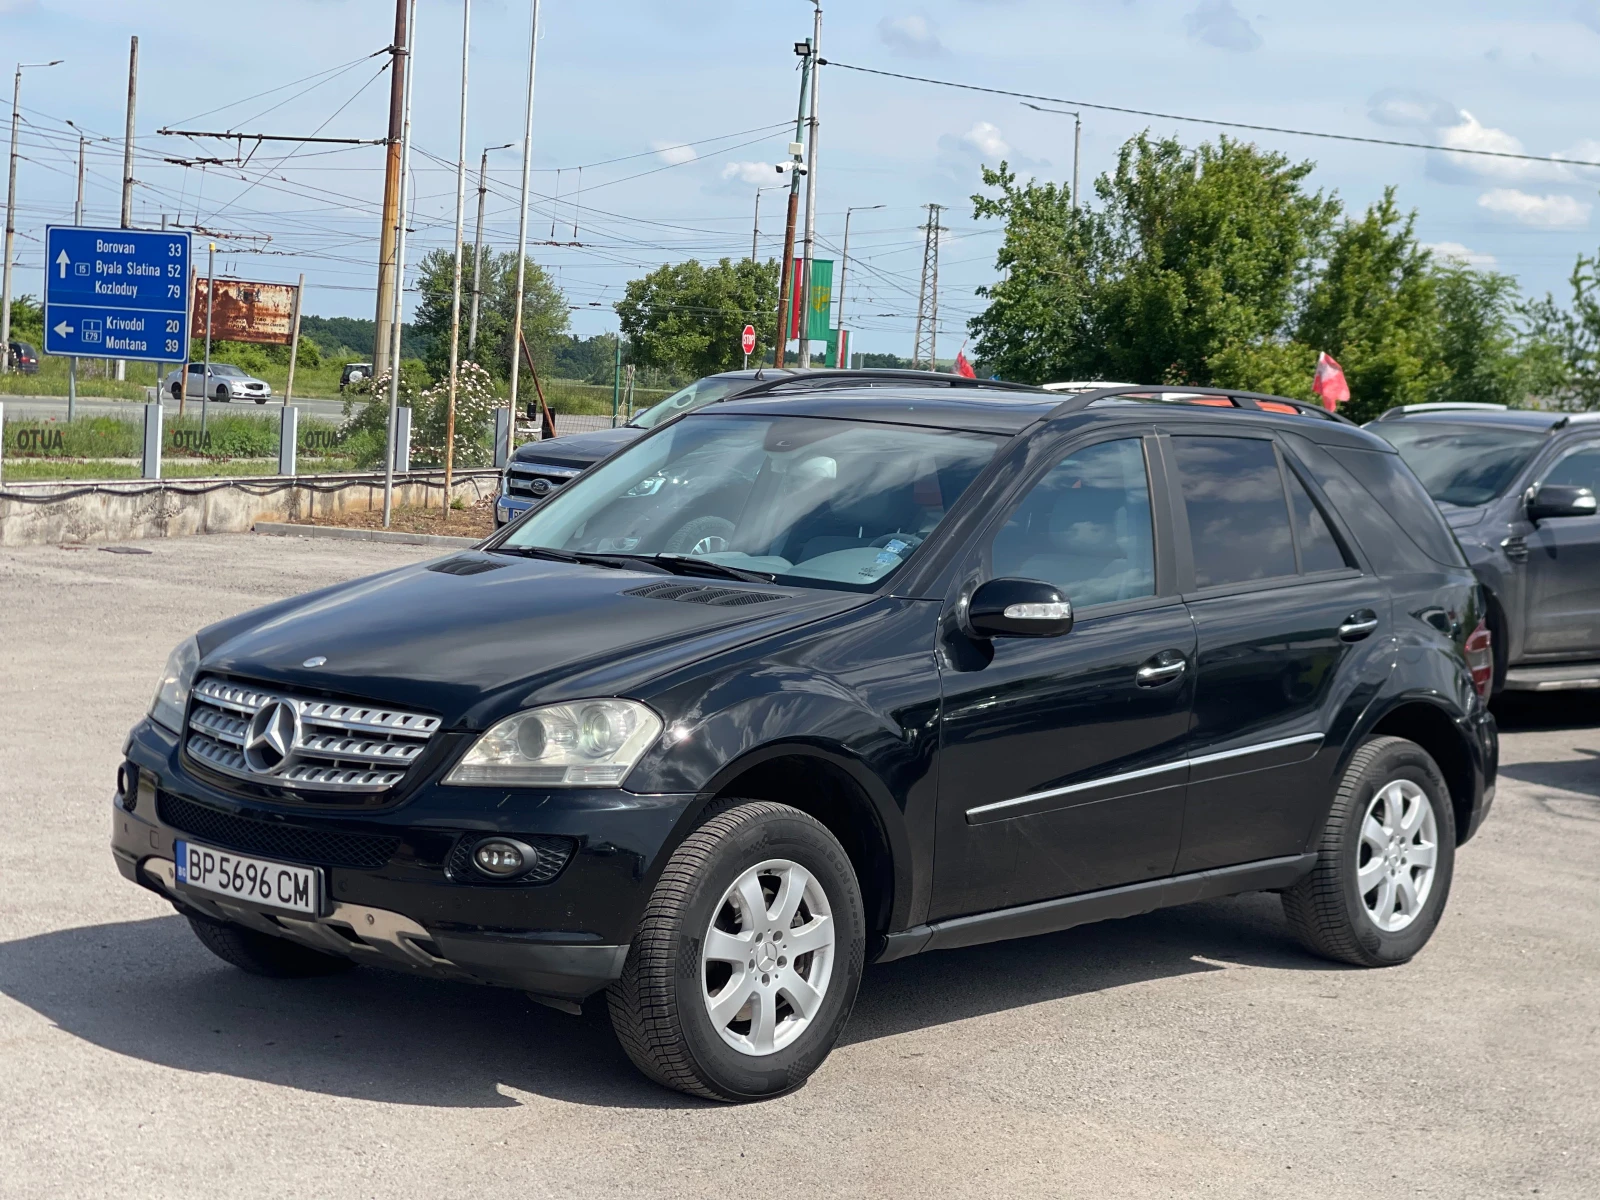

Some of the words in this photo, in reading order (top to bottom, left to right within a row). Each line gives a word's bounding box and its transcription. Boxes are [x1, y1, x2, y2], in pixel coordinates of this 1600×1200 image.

[96, 239, 135, 254] Borovan
[168, 243, 182, 257] 33
[79, 265, 86, 274] 15
[95, 260, 122, 276] Byala
[126, 262, 161, 277] Slatina
[167, 264, 181, 278] 52
[95, 280, 138, 299] Kozloduy
[167, 285, 181, 298] 79
[106, 316, 145, 331] Krivodol
[166, 320, 180, 333] 20
[85, 331, 98, 341] E79
[106, 336, 147, 351] Montana
[165, 339, 179, 352] 39
[742, 333, 755, 345] STOP
[189, 849, 215, 884] BP
[218, 856, 272, 899] 5696
[277, 870, 309, 908] CM
